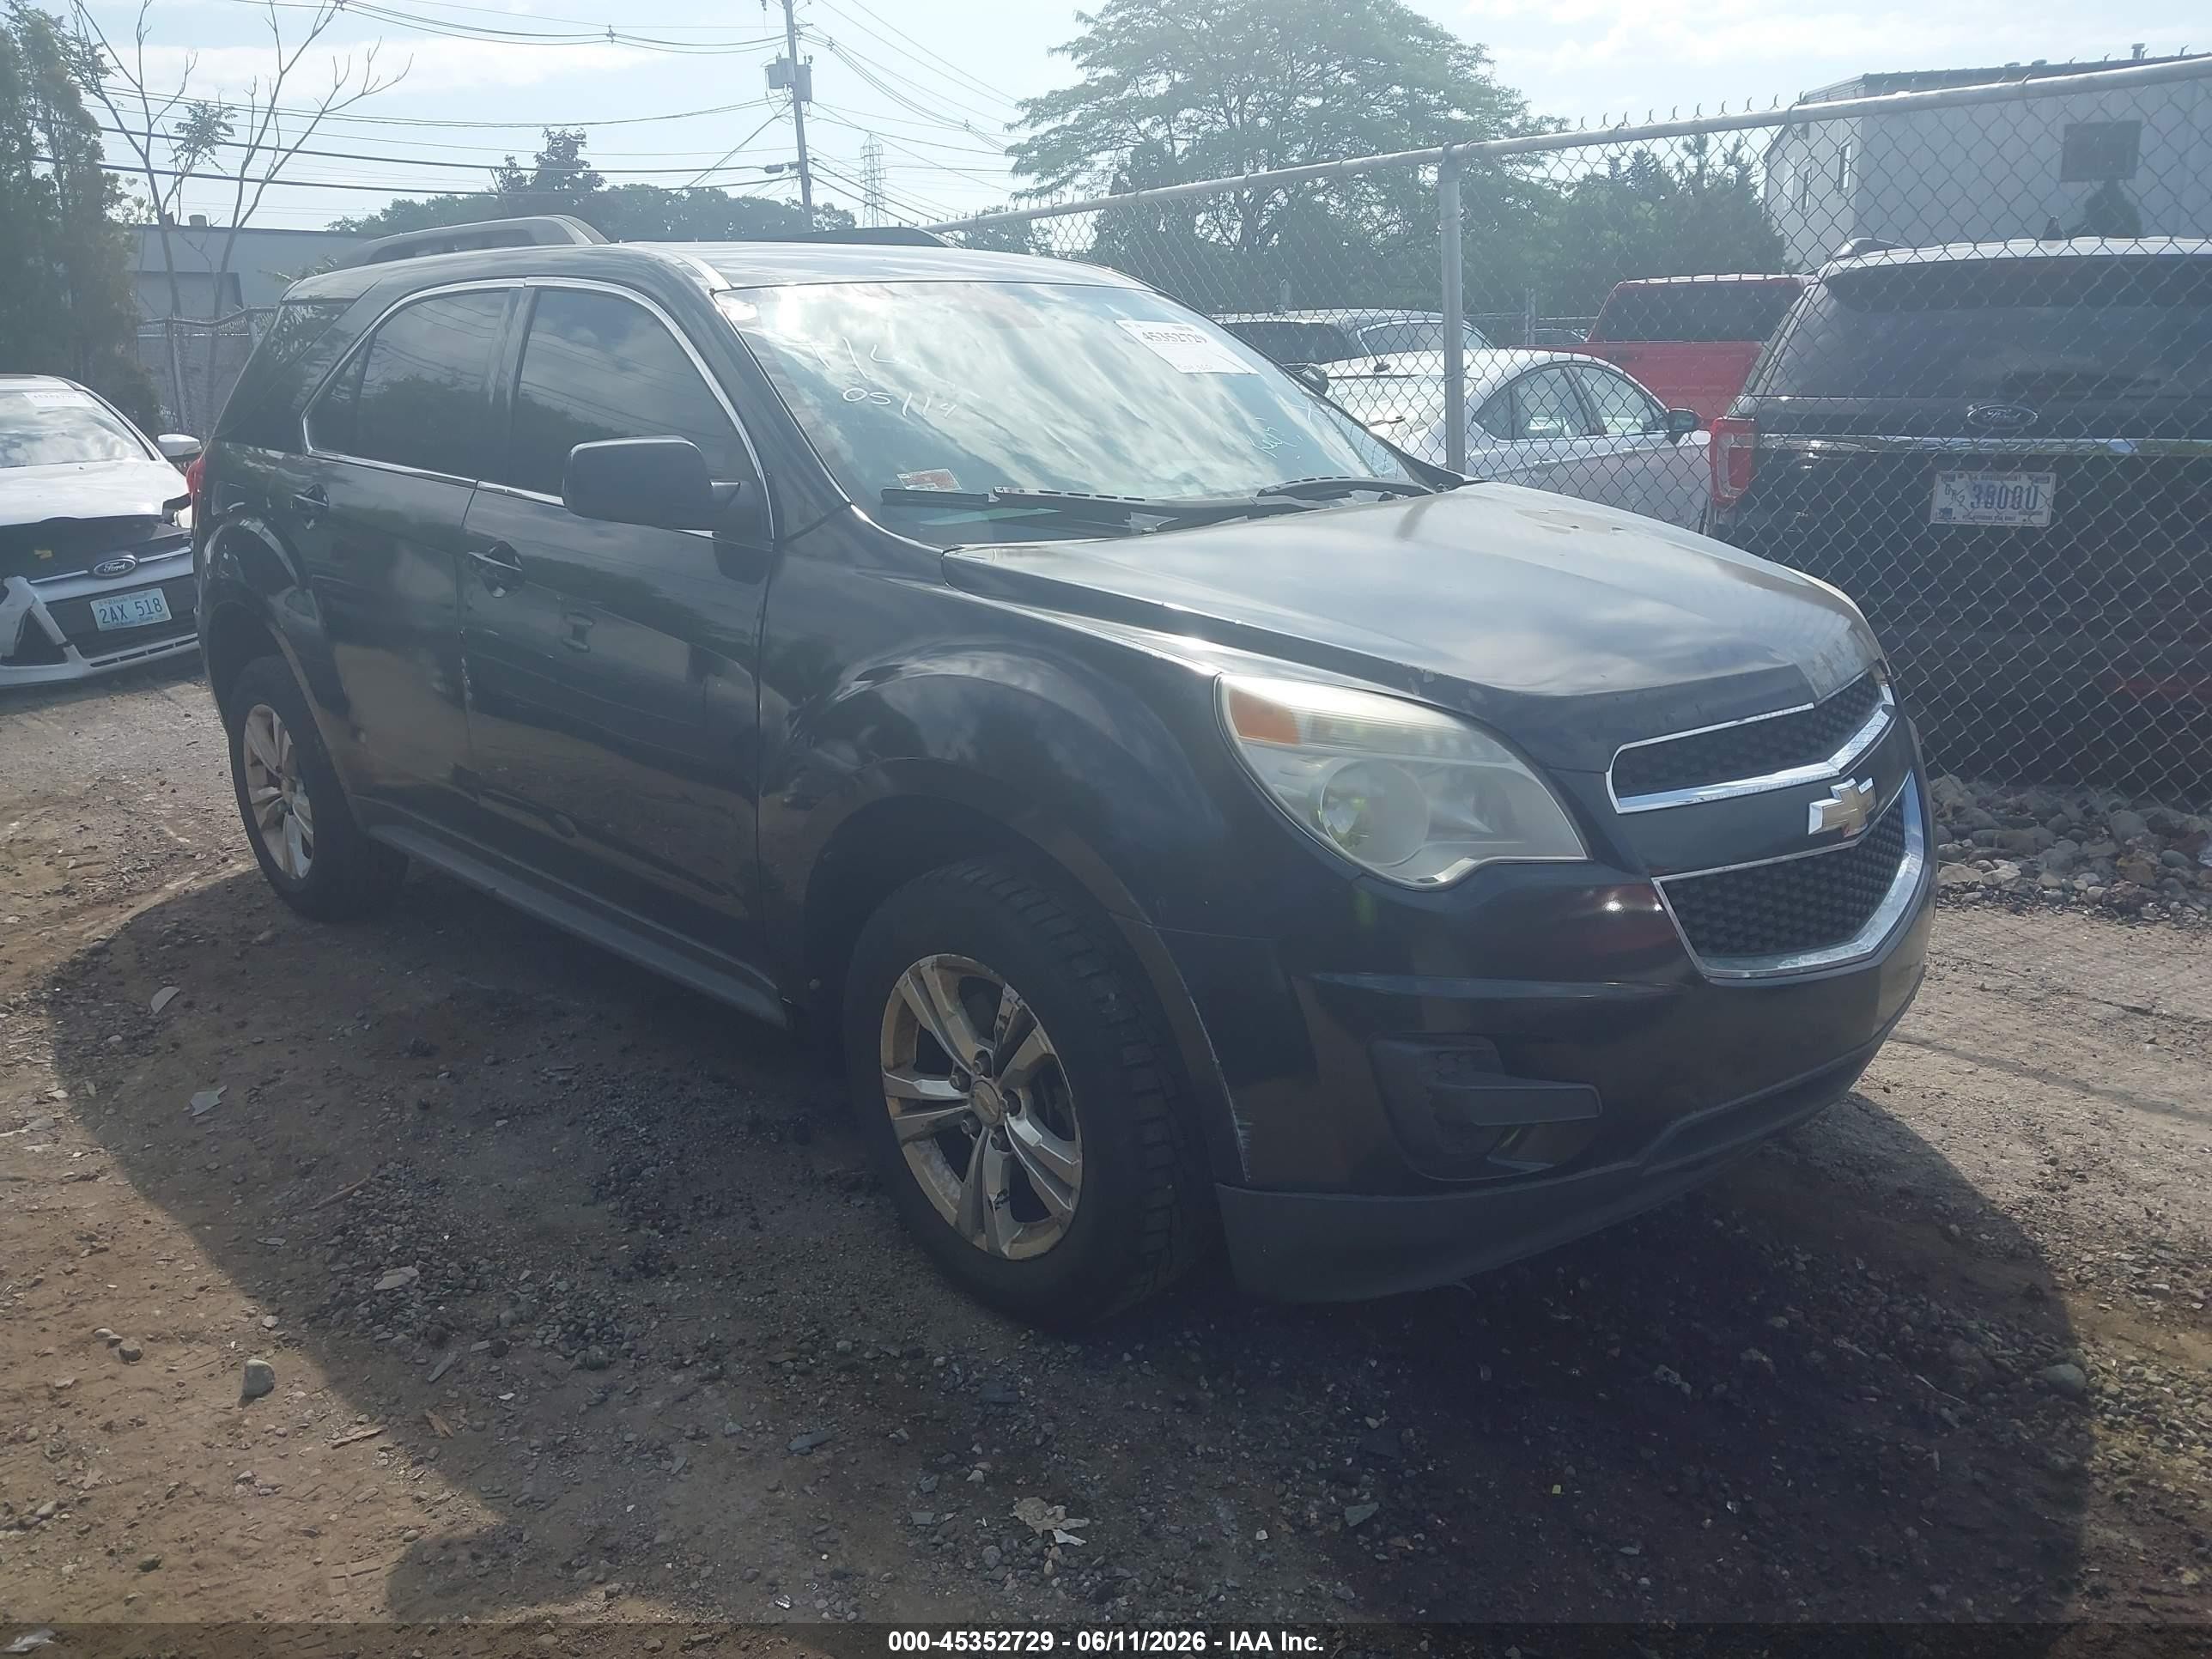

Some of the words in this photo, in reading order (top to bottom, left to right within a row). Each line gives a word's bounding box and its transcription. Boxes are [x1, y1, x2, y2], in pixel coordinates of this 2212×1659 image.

[1142, 331, 1208, 343] 45352729
[103, 562, 126, 573] Ford
[100, 605, 129, 623] 2AX
[134, 598, 162, 616] 518
